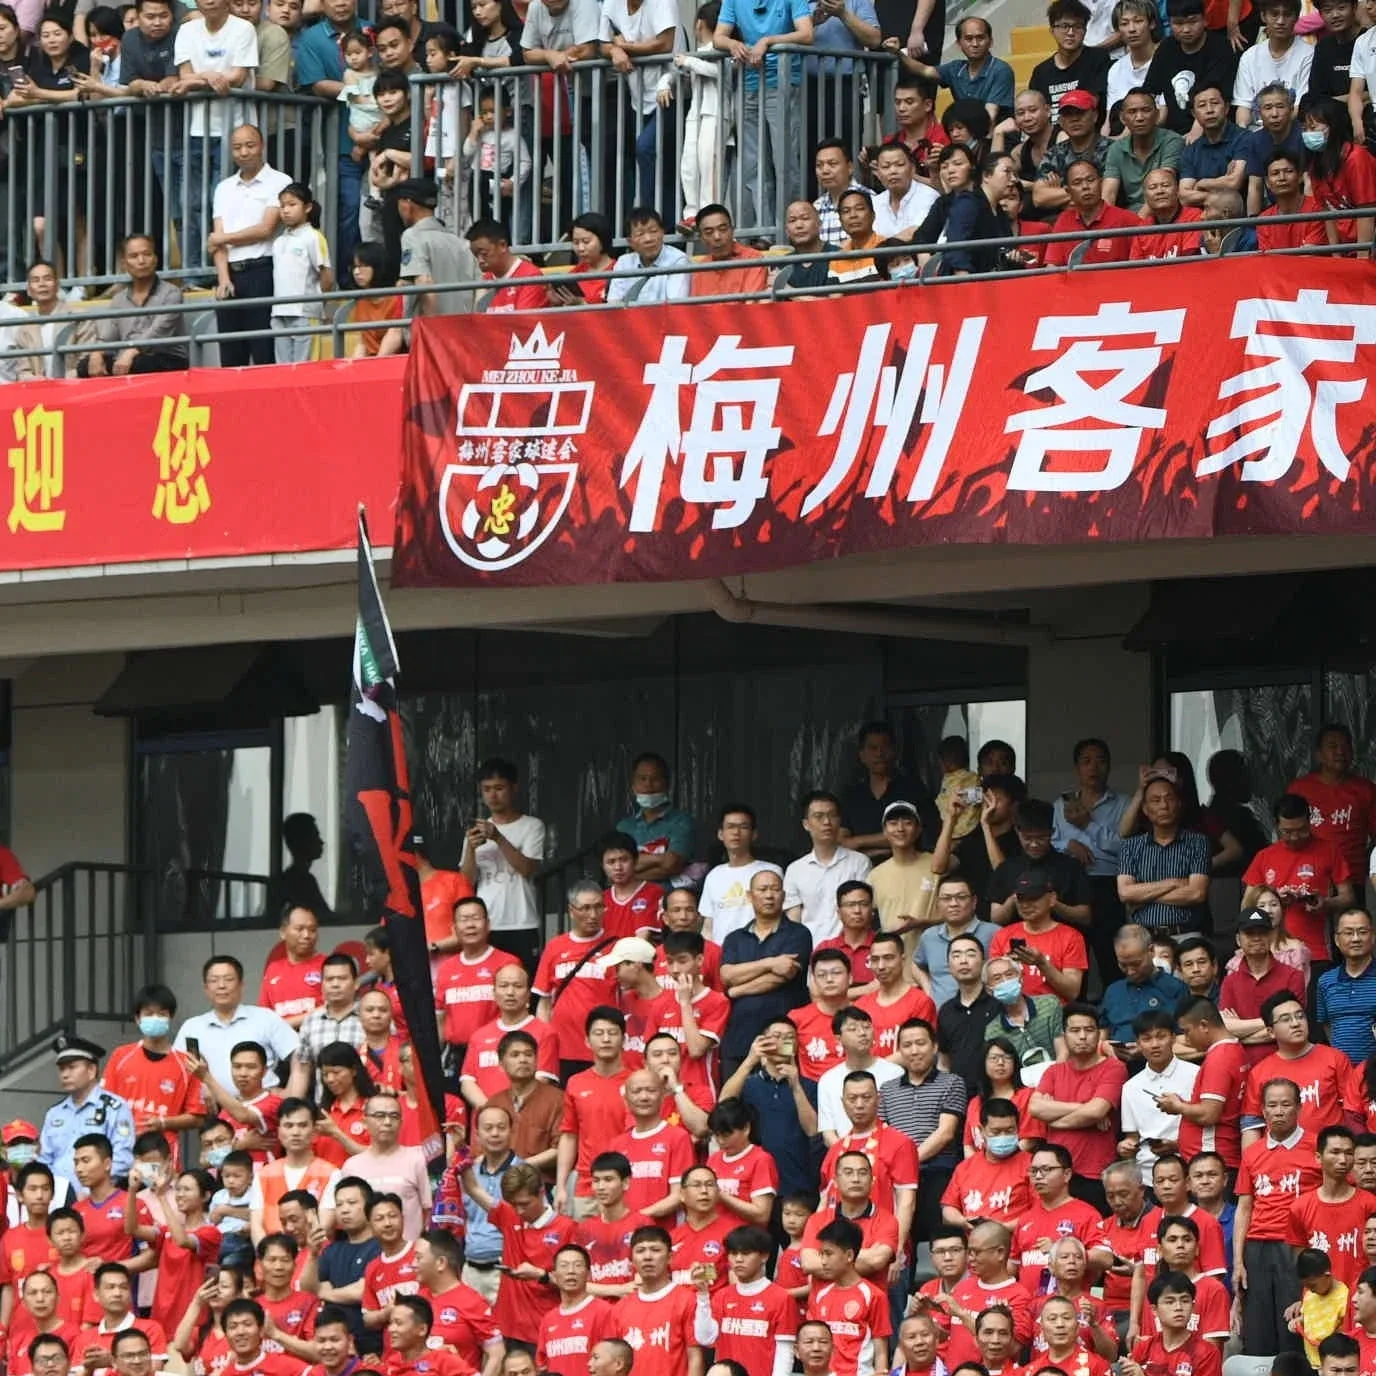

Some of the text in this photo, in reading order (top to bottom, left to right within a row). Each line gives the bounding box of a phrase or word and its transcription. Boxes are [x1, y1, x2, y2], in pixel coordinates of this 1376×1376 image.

[507, 369, 540, 384] ZHOU
[621, 288, 1376, 534] 梅州客家
[1310, 806, 1352, 830] 梅州
[1255, 1169, 1300, 1198] 梅州
[964, 1186, 1011, 1213] 梅州
[1309, 1229, 1358, 1257] 梅州
[624, 1323, 670, 1350] 梅州
